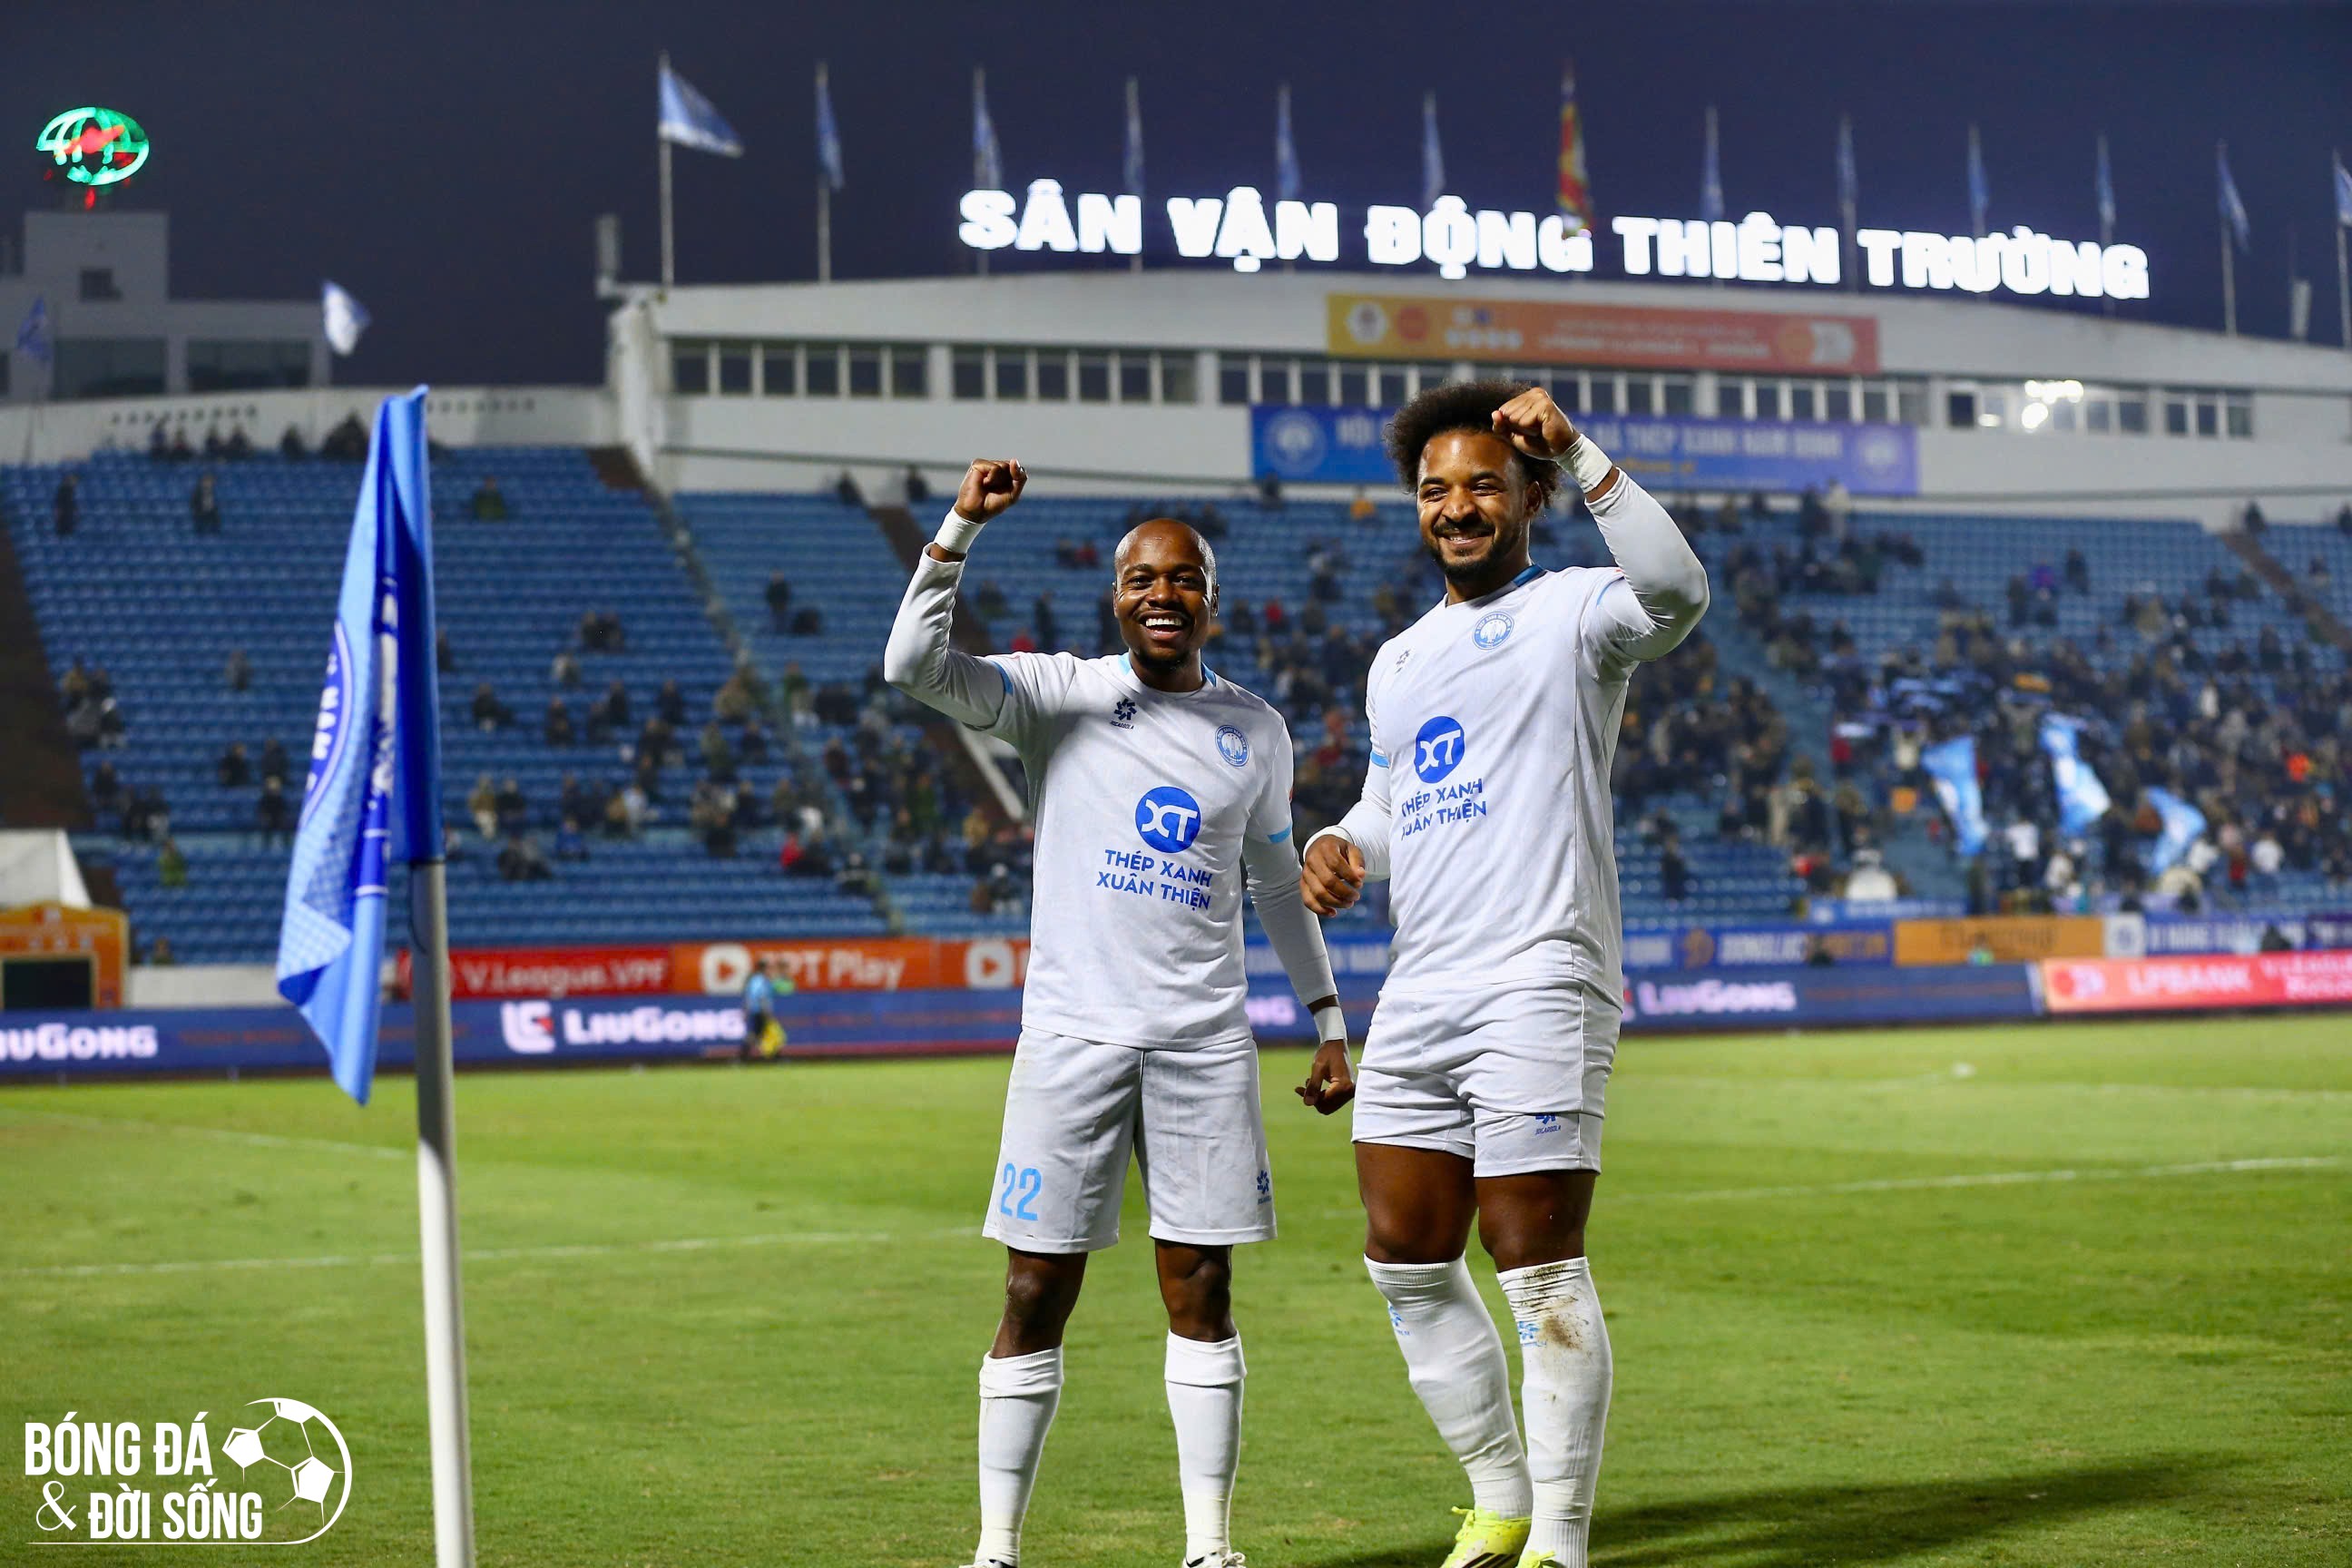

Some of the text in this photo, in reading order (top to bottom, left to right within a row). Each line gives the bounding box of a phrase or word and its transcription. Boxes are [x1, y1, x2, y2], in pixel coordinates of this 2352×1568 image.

[959, 179, 2150, 299] SÂN VẬN ĐỘNG THIÊN TRƯỜNG
[1436, 778, 1483, 804] XANH
[1436, 798, 1487, 823] THIỆN
[1104, 849, 1213, 887] THÉP XANH
[1096, 871, 1211, 911] XUÂN THIỆN
[828, 948, 906, 991] Play
[1000, 1162, 1042, 1221] 22
